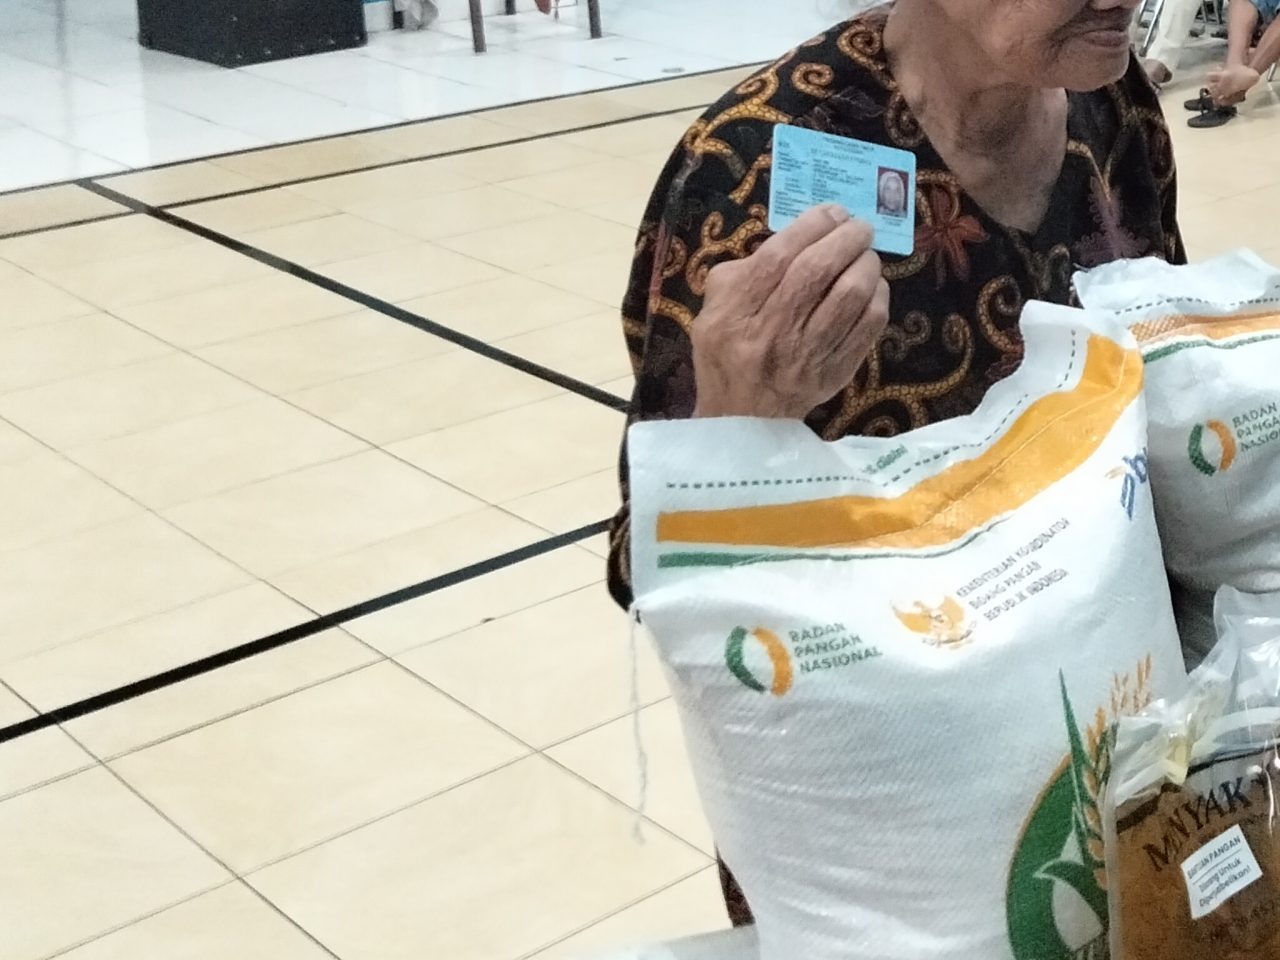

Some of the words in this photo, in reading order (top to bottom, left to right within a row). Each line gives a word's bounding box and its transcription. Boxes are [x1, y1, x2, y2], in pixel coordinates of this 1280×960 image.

[1231, 401, 1277, 428] BADAN
[788, 622, 846, 643] BADAN
[794, 633, 863, 658] PANGAN
[799, 646, 883, 674] NASIONAL
[1209, 836, 1242, 863] PANGAN
[1220, 856, 1242, 877] Untuk
